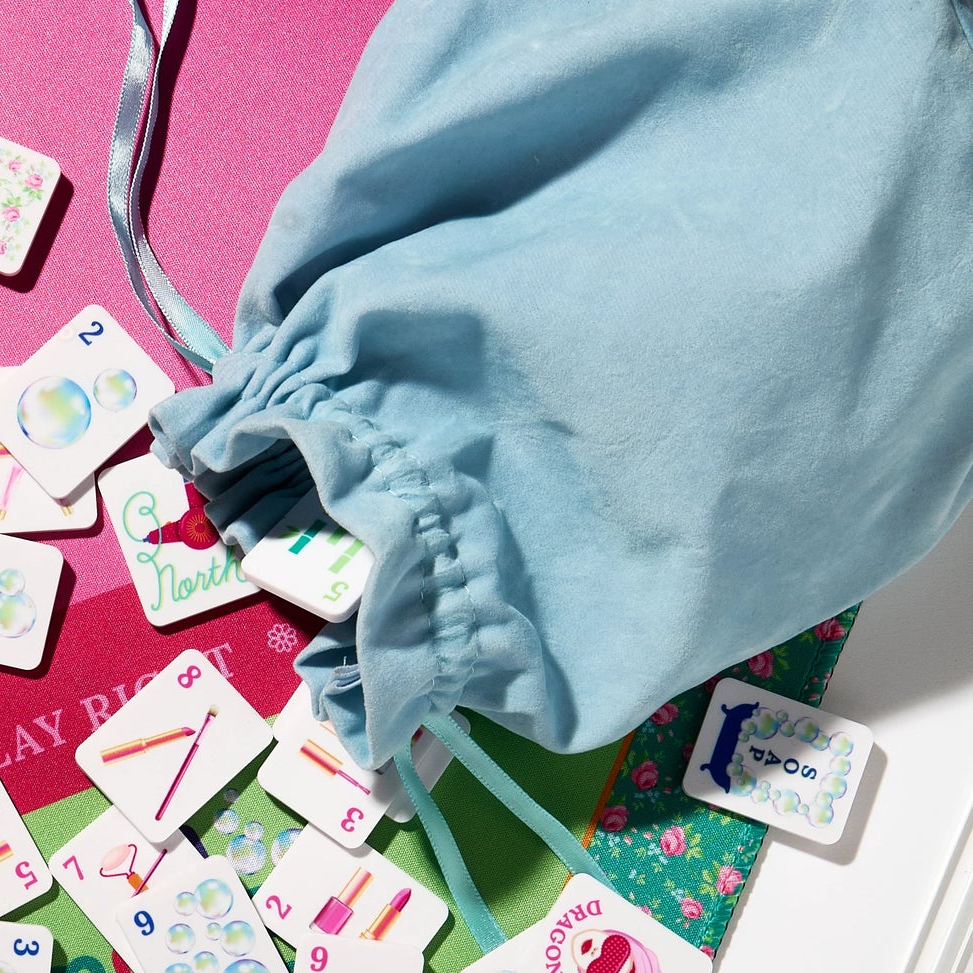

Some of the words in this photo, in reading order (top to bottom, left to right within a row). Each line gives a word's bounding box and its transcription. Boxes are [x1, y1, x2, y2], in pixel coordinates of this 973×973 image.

[78, 320, 104, 347] 2
[149, 547, 248, 612] North
[323, 580, 349, 604] 5
[80, 643, 234, 733] RIT
[177, 664, 202, 688] 8
[749, 745, 818, 781] SOAP
[340, 806, 365, 833] 3
[15, 860, 39, 890] 5
[62, 855, 85, 881] 7
[265, 894, 293, 920] 2
[133, 909, 155, 936] 9
[12, 937, 40, 956] 3
[310, 945, 329, 972] 9
